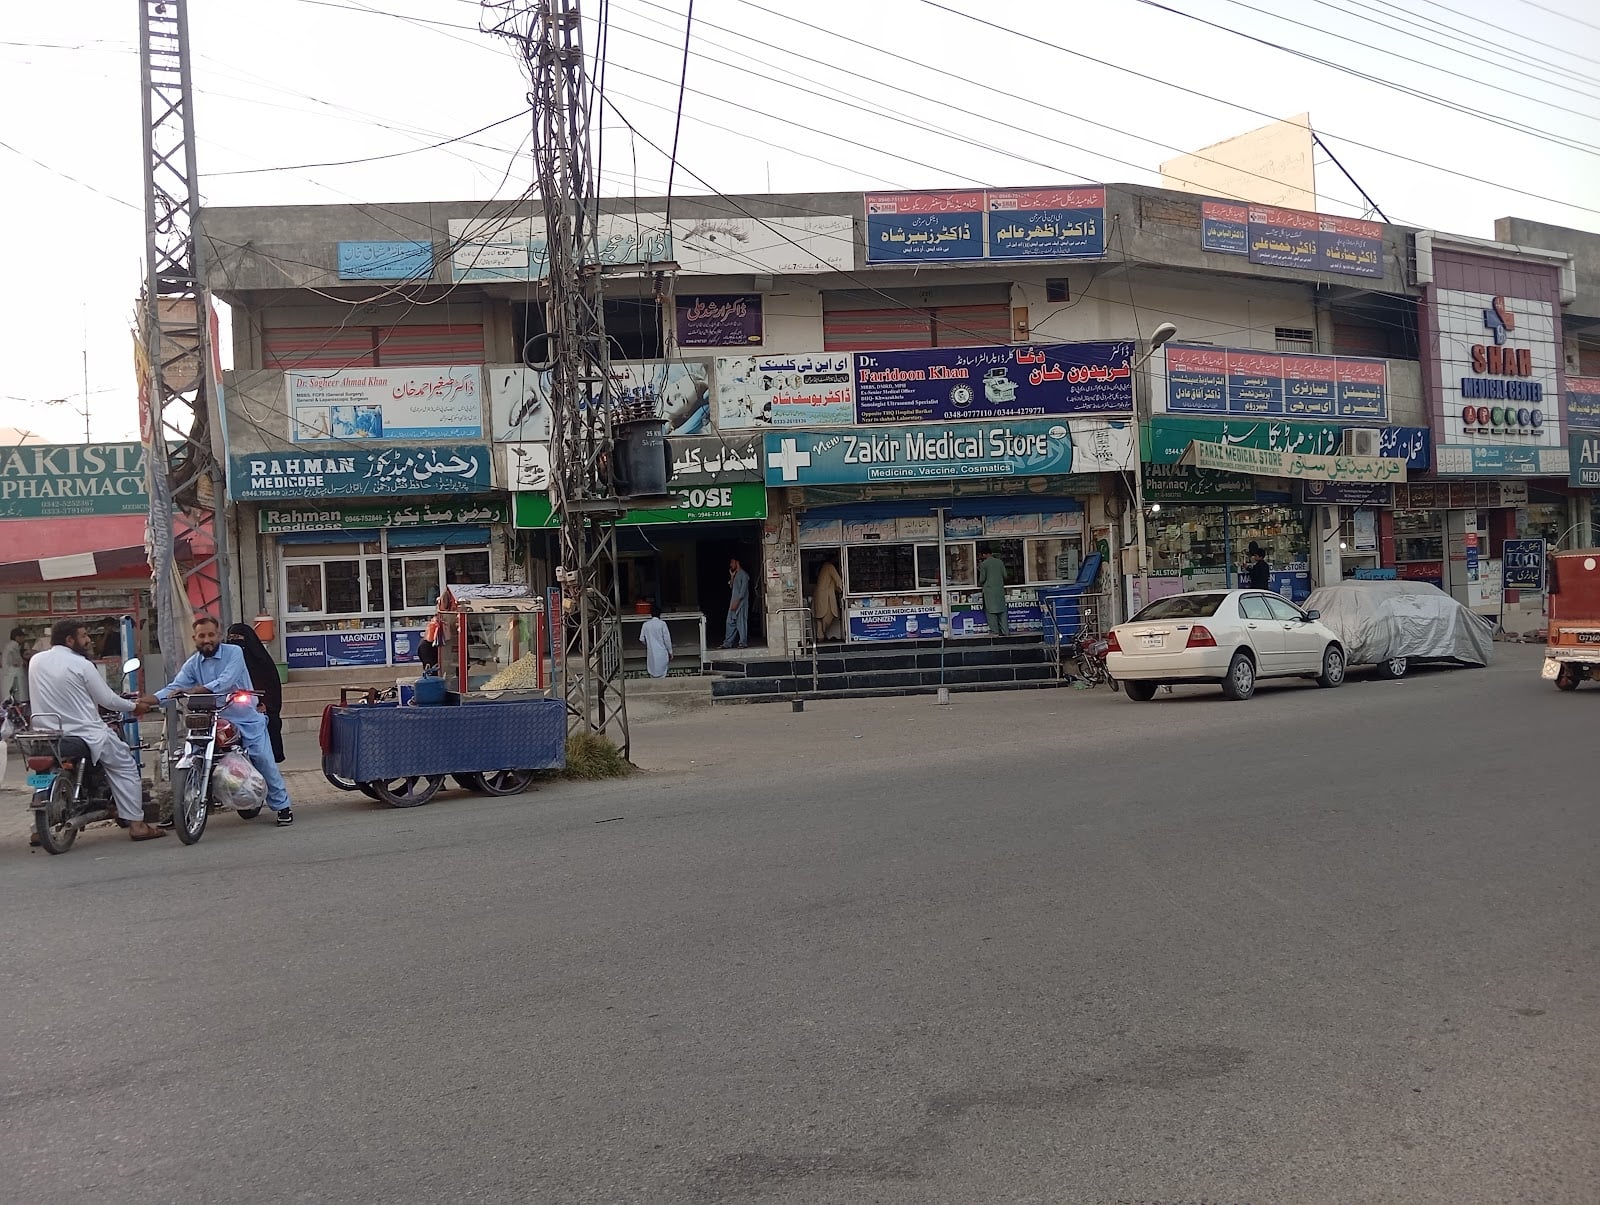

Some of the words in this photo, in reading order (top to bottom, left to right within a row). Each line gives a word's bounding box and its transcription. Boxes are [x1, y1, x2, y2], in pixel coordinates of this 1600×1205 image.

[881, 227, 906, 242] شاہ
[905, 228, 935, 244] زبیر
[936, 222, 971, 244] ڈاکٹر
[997, 224, 1025, 244] عالم
[1025, 223, 1060, 241] اظہر
[1058, 218, 1096, 239] ڈاکٹر
[1252, 236, 1270, 251] علی
[1295, 240, 1317, 255] ڈاکٹر
[720, 297, 747, 322] ڈاکٹر
[1109, 342, 1130, 362] ڈاکٹر
[1471, 344, 1533, 376] SHAH
[759, 358, 797, 374] کلینک
[797, 357, 814, 374] ٹی
[815, 358, 833, 373] این
[834, 357, 848, 371] ای
[859, 355, 879, 367] Dr.
[859, 368, 926, 384] Faridoon
[928, 366, 970, 380] Khan
[1029, 362, 1065, 386] خان
[1067, 359, 1130, 384] فریدون
[296, 378, 308, 388] Dr.
[309, 378, 339, 389] Sagheer
[340, 376, 367, 387] Ahmad
[367, 375, 388, 387] Khan
[449, 373, 476, 402] ڈاکٹر
[1461, 377, 1507, 400] MEDICAL
[1506, 379, 1543, 402] CENTER
[393, 381, 415, 401] خان
[773, 390, 792, 406] شاہ
[791, 391, 823, 407] یوسف
[822, 387, 851, 407] ڈاکٹر
[1204, 388, 1221, 400] ڈاکٹر
[895, 409, 915, 417] Hospital
[944, 409, 992, 419] 0348-0777110
[997, 407, 1045, 417] 0344-4279771
[1290, 401, 1305, 413] جی
[1305, 404, 1321, 413] سی
[1321, 400, 1331, 413] ای
[812, 436, 840, 456] New
[842, 433, 903, 464] Zakir
[905, 430, 984, 463] Medical
[989, 427, 1049, 458] Store
[704, 443, 759, 478] شہاب
[1199, 443, 1224, 460] FARAZ
[1225, 446, 1258, 464] MEDICAL
[1259, 451, 1283, 467] STORE
[250, 457, 356, 477] RAHMAN
[363, 449, 414, 482] میڈیکوز
[871, 468, 917, 478] Medicine,
[918, 466, 959, 476] Vaccine,
[960, 464, 1011, 475] Cosmatics
[1286, 456, 1327, 475] سٹور
[1326, 459, 1374, 481] میڈیکل
[1373, 461, 1400, 481] فراز
[2, 476, 149, 500] PHARMACY
[252, 475, 325, 490] MEDICOSE
[1146, 479, 1189, 492] Pharmacy
[268, 510, 341, 524] Rahman
[269, 522, 342, 532] medicose
[1008, 601, 1038, 609] MEDICAL
[861, 615, 897, 624] MAGNIZEN
[340, 633, 384, 643] MAGNIZEN
